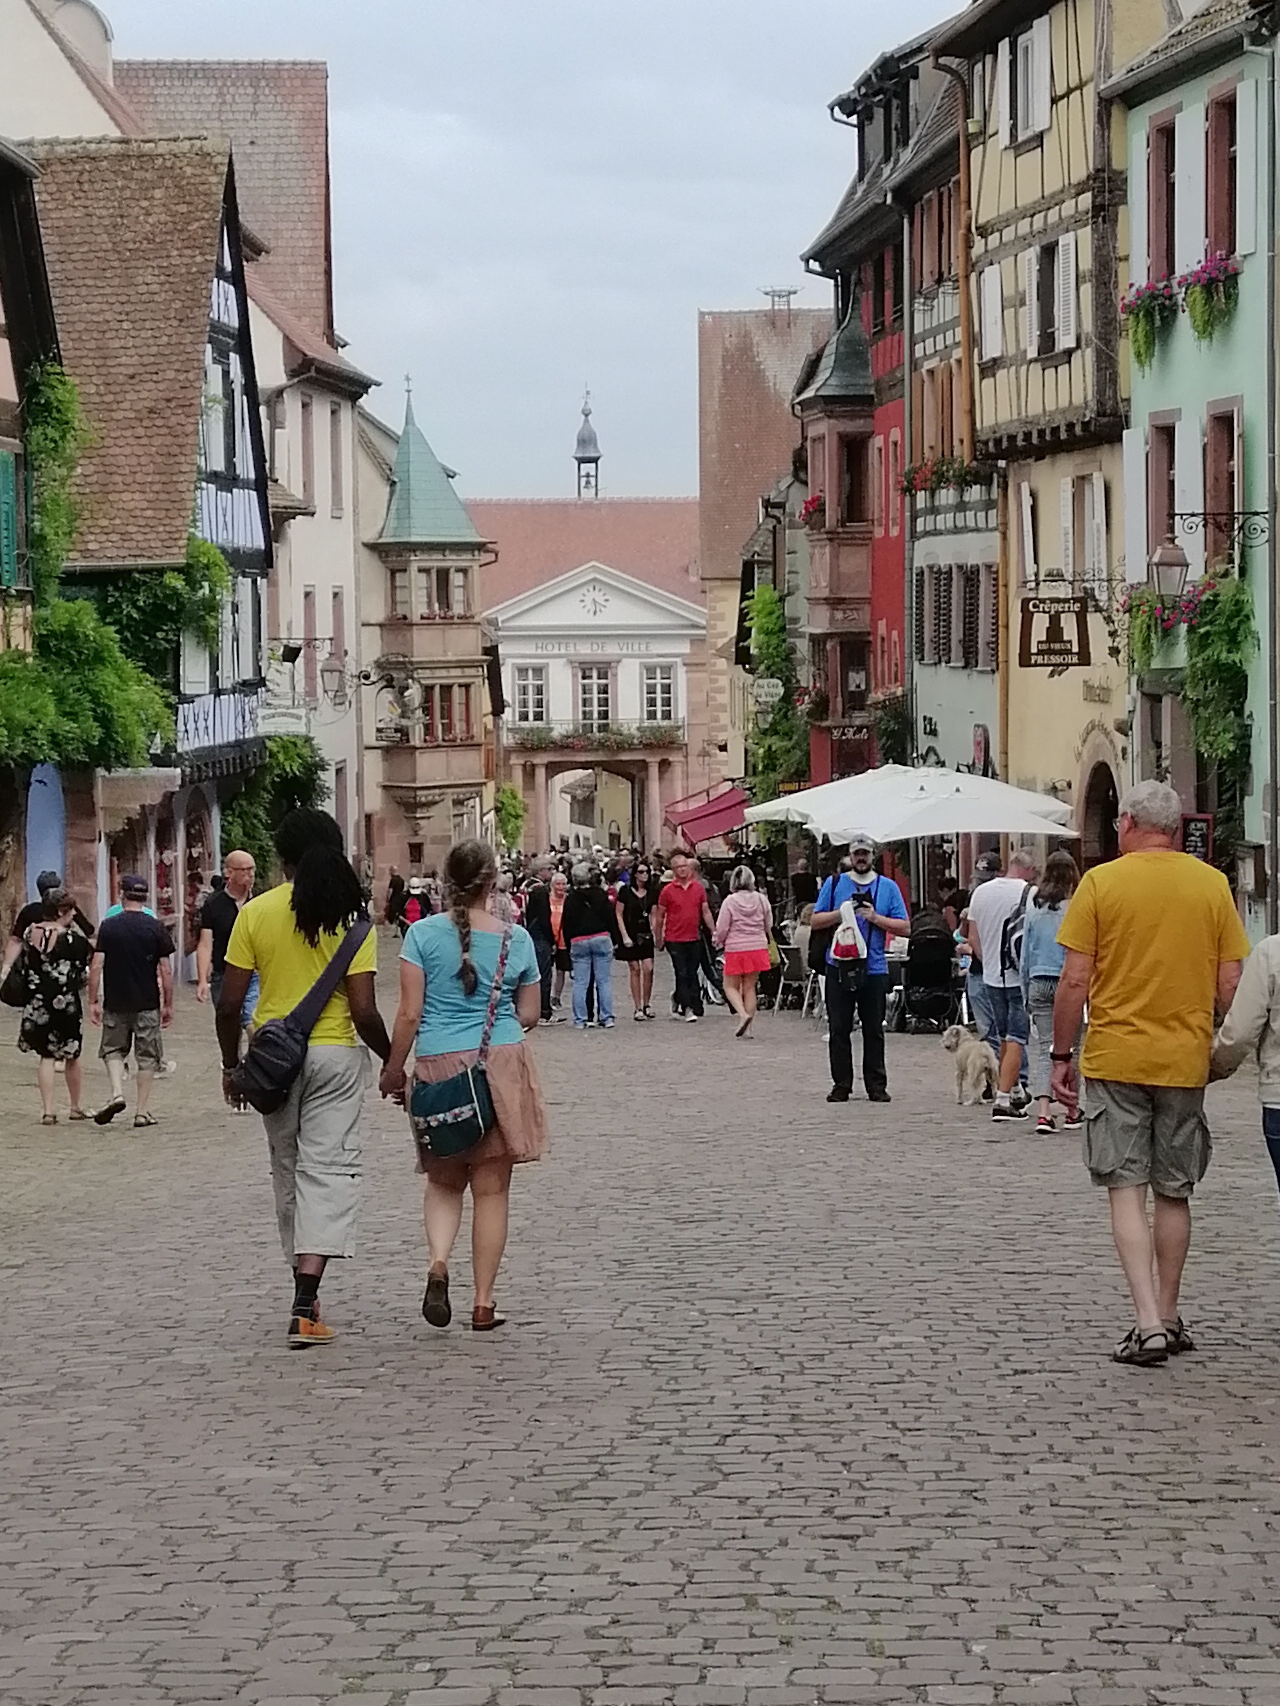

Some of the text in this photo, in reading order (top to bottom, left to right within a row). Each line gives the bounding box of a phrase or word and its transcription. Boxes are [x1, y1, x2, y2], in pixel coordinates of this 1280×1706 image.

[1028, 599, 1081, 615] Crêperie
[535, 641, 652, 652] HOTEL DE VILLE
[1030, 654, 1080, 664] PRESSOIR
